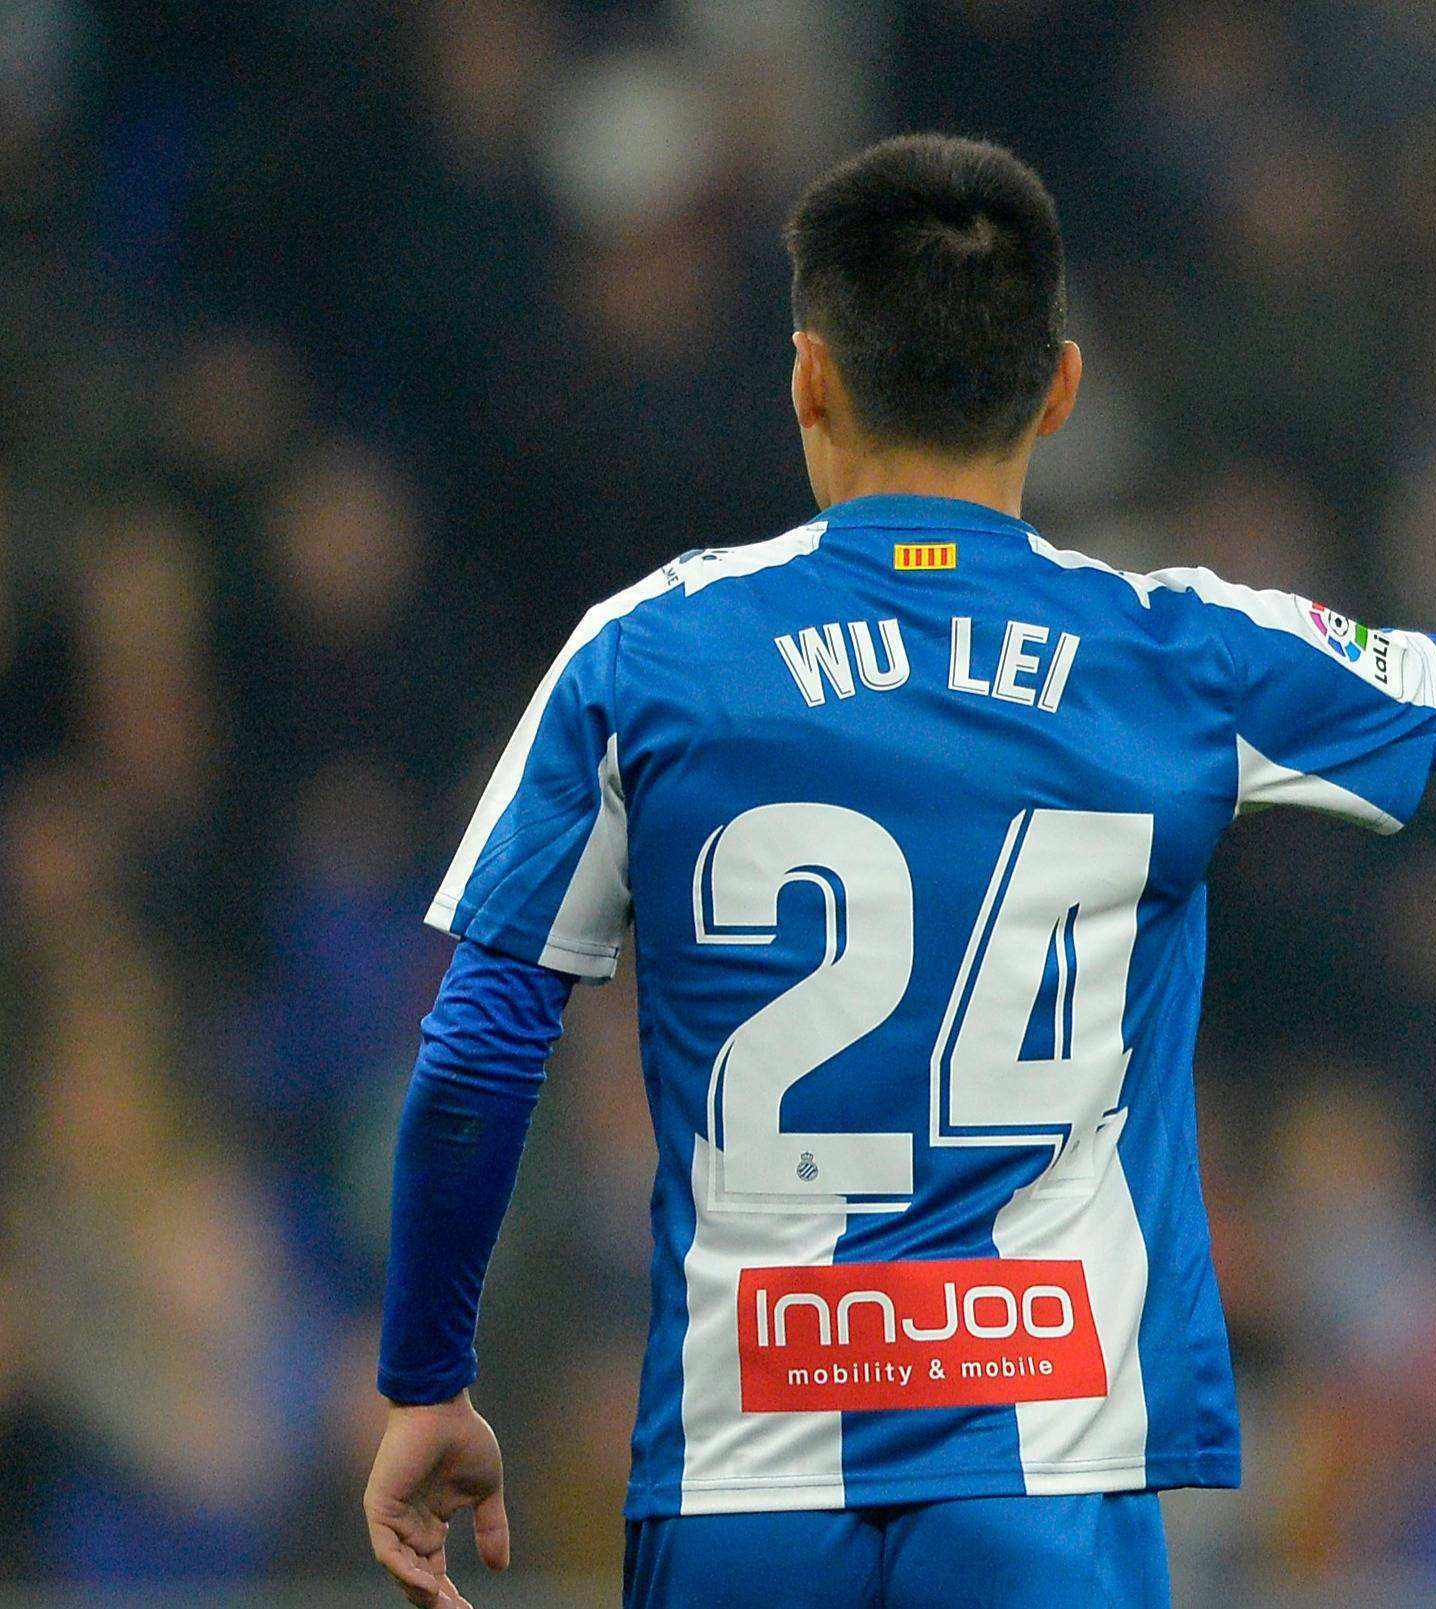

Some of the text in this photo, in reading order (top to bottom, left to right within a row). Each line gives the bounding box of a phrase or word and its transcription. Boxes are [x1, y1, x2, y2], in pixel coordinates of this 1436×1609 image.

[774, 617, 1080, 714] WU LEI
[1373, 634, 1390, 684] LaLi
[692, 802, 1154, 1213] 24
[787, 1355, 1054, 1387] mobility & mobile
